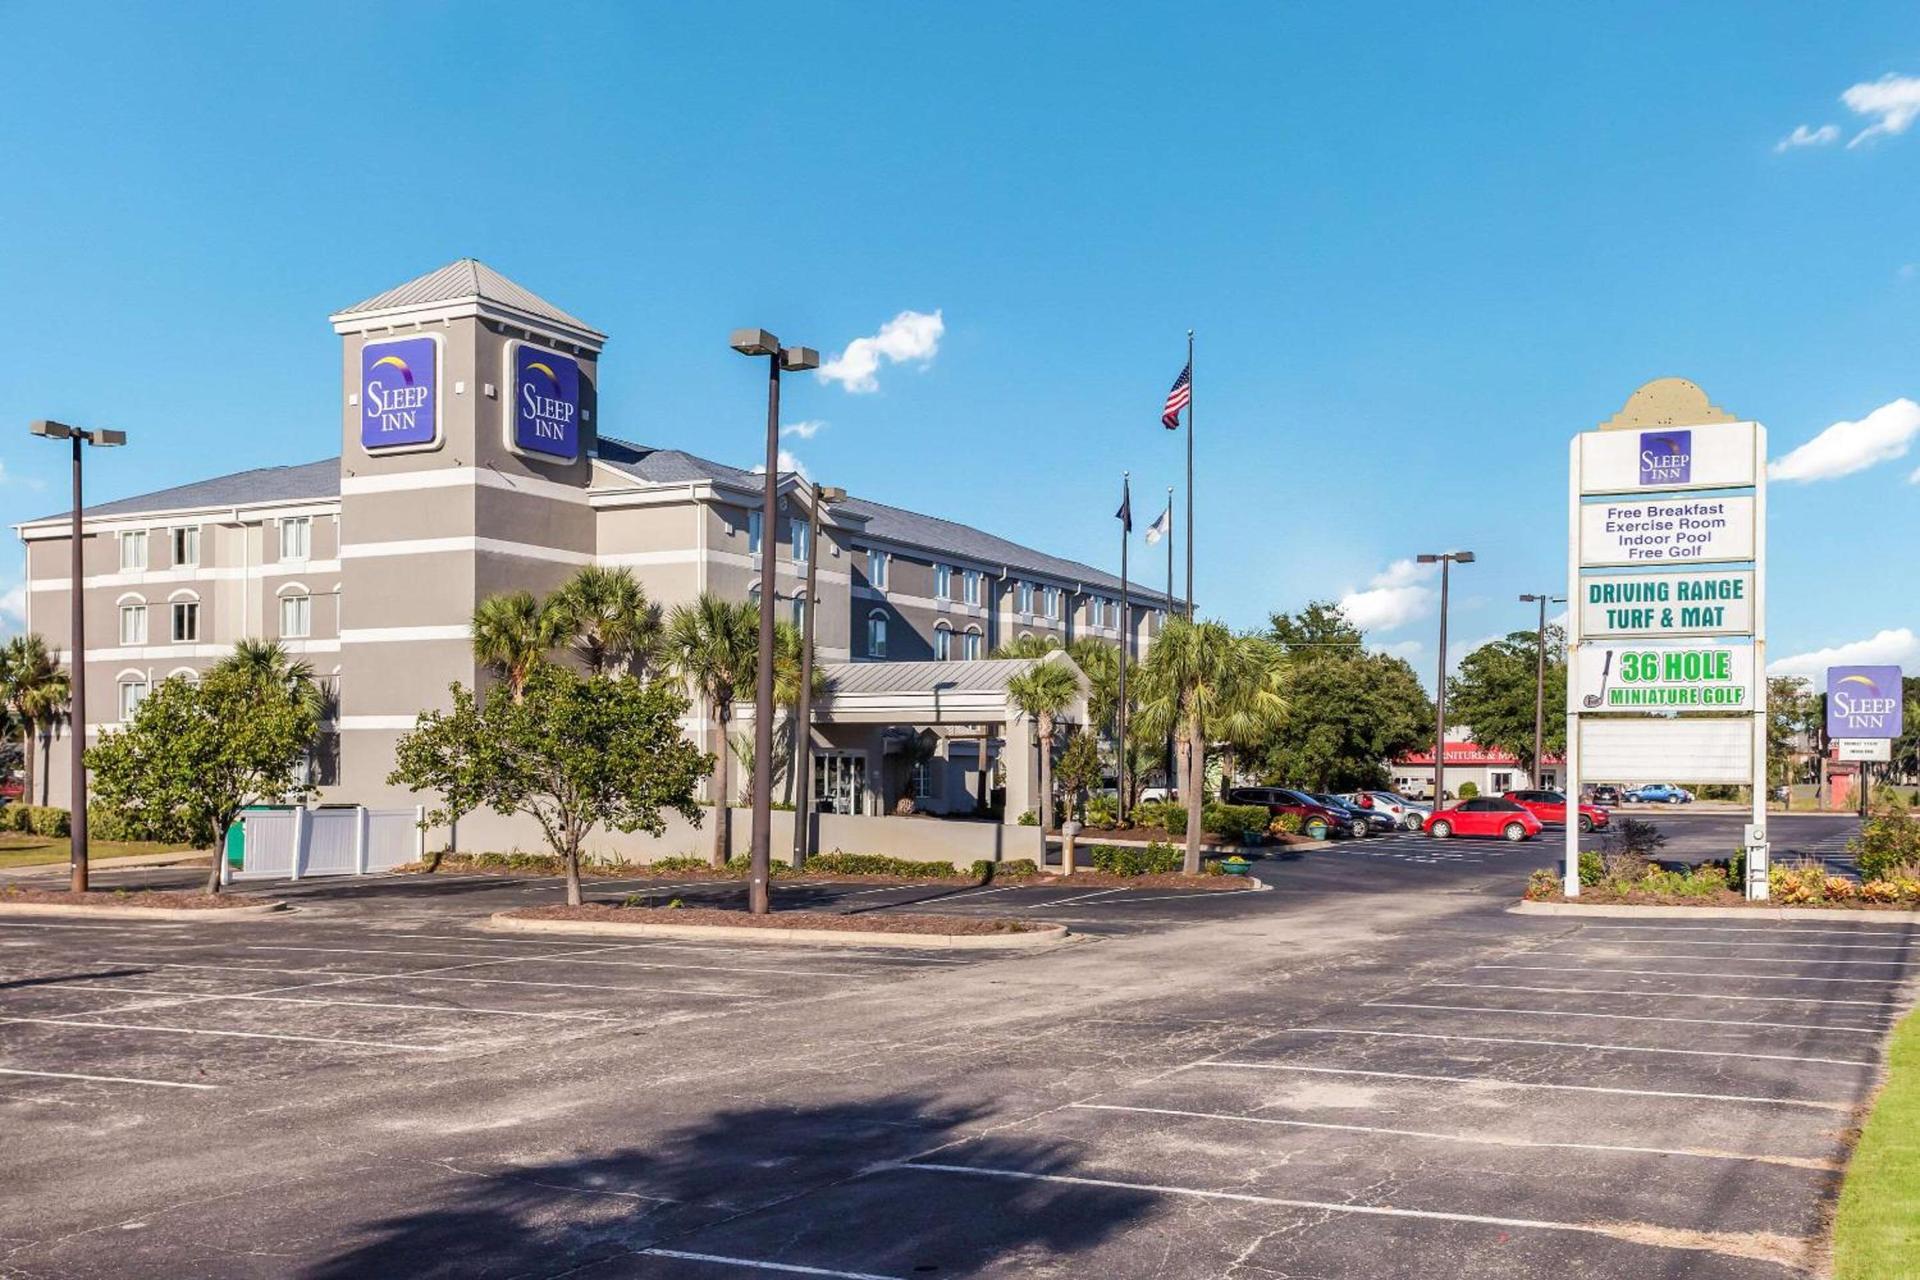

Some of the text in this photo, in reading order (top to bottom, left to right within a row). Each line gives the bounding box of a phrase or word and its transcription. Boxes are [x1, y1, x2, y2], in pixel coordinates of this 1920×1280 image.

[367, 380, 428, 418] SLEEP
[522, 382, 574, 424] SLEEP
[381, 411, 417, 431] INN
[535, 419, 565, 440] INN
[1641, 450, 1690, 473] SLEEP
[1651, 467, 1681, 480] INN
[1607, 503, 1724, 519] Free Breakfast
[1605, 518, 1726, 533] Exercise Room
[1618, 531, 1712, 546] Indoor Pool
[1628, 545, 1703, 559] Free Golf
[1589, 579, 1744, 604] DRIVING RANGE
[1606, 606, 1725, 629] TURF & MAT
[1621, 651, 1731, 682] 36 HOLE
[1610, 687, 1743, 704] MINIATURE GOLF
[1833, 691, 1896, 718] SLEEP
[1848, 715, 1884, 728] INN
[1424, 751, 1486, 760] NITURE
